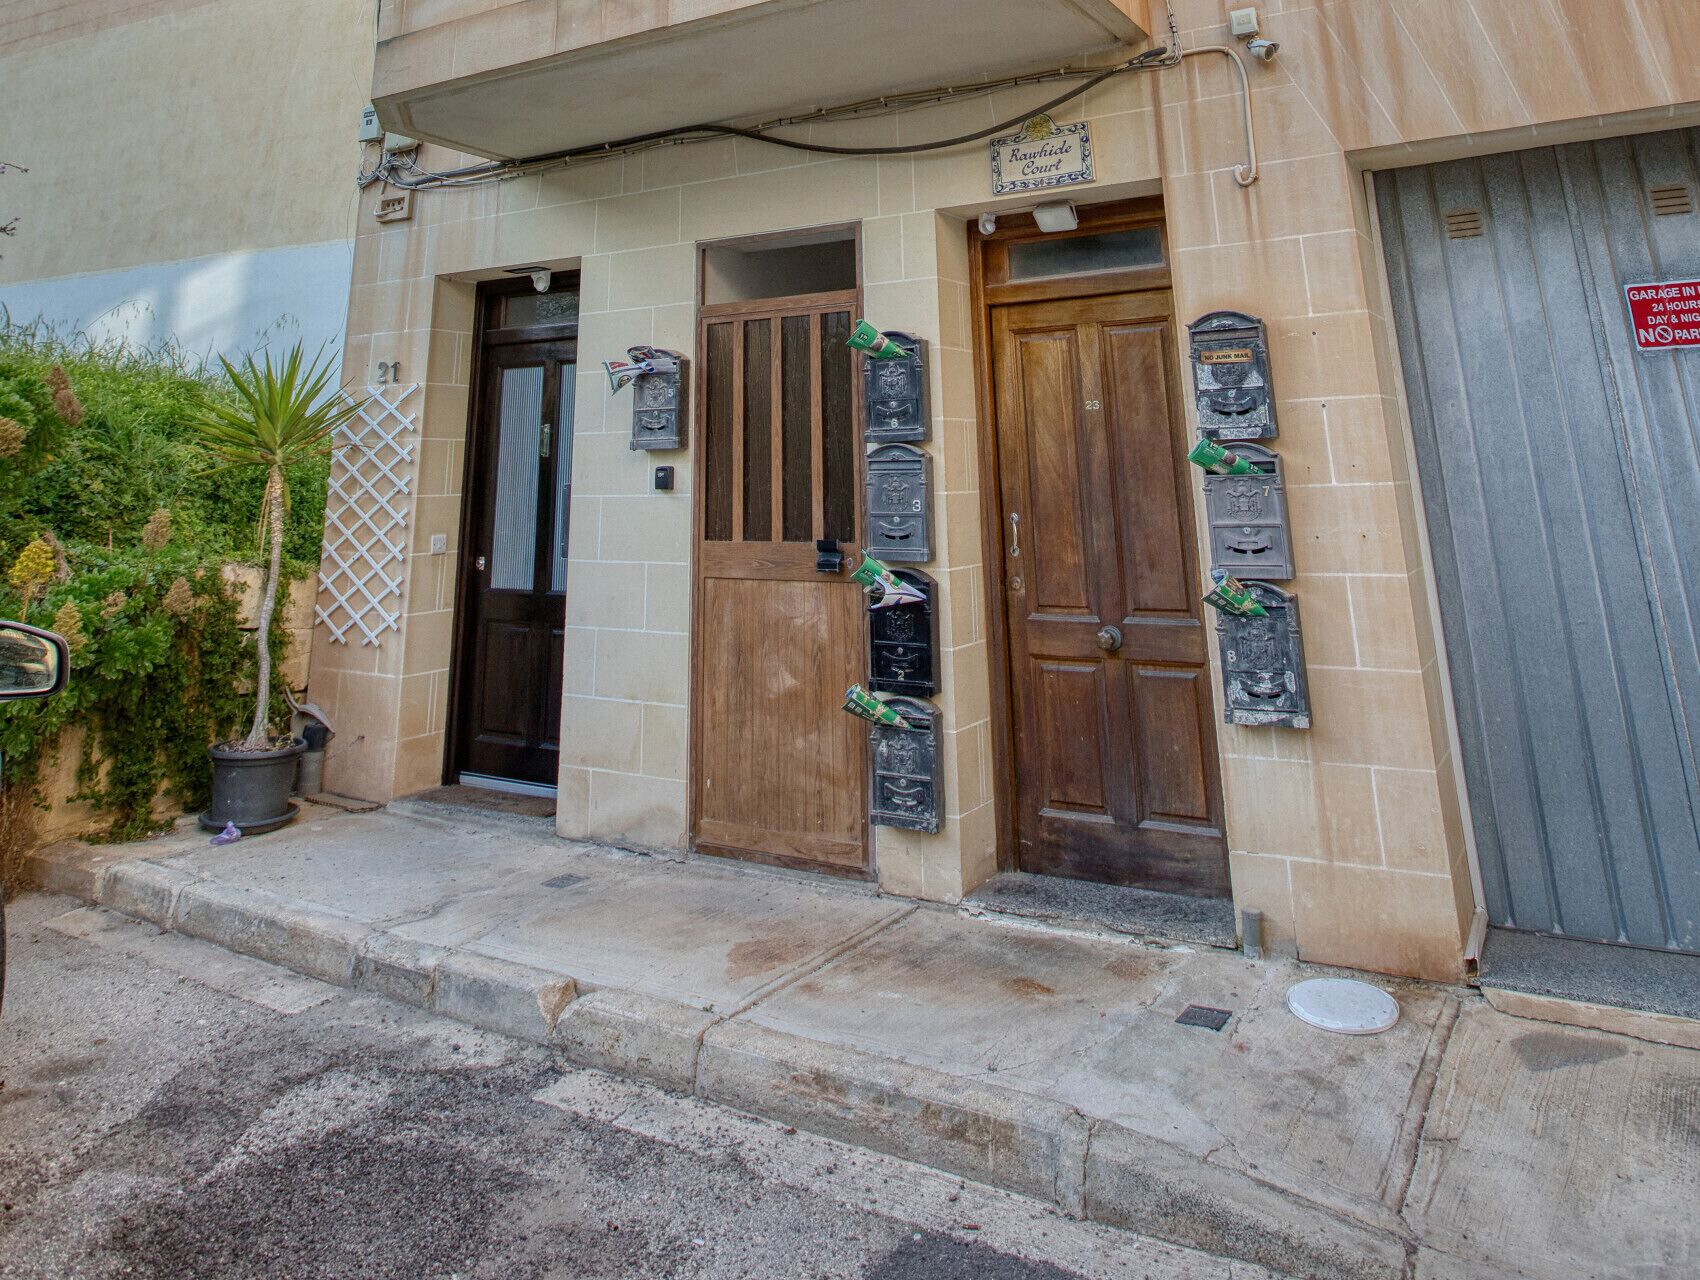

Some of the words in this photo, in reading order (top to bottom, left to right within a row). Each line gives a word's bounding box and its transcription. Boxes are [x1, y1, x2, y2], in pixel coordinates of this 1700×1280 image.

[1008, 140, 1072, 163] Rawhide
[1022, 158, 1062, 176] Court
[1629, 287, 1681, 301] GARAGE
[1682, 286, 1696, 297] IN
[1652, 303, 1664, 312] 24
[1647, 315, 1668, 325] DAY
[1671, 314, 1679, 324] &
[1674, 328, 1700, 340] PAR
[1204, 353, 1214, 361] NO
[378, 361, 400, 383] 21
[668, 388, 674, 398] 5
[1086, 400, 1099, 410] 23
[891, 418, 898, 428] 6
[1262, 485, 1270, 497] 7
[912, 499, 921, 512] 3
[1227, 650, 1236, 662] 8
[897, 670, 904, 681] 2
